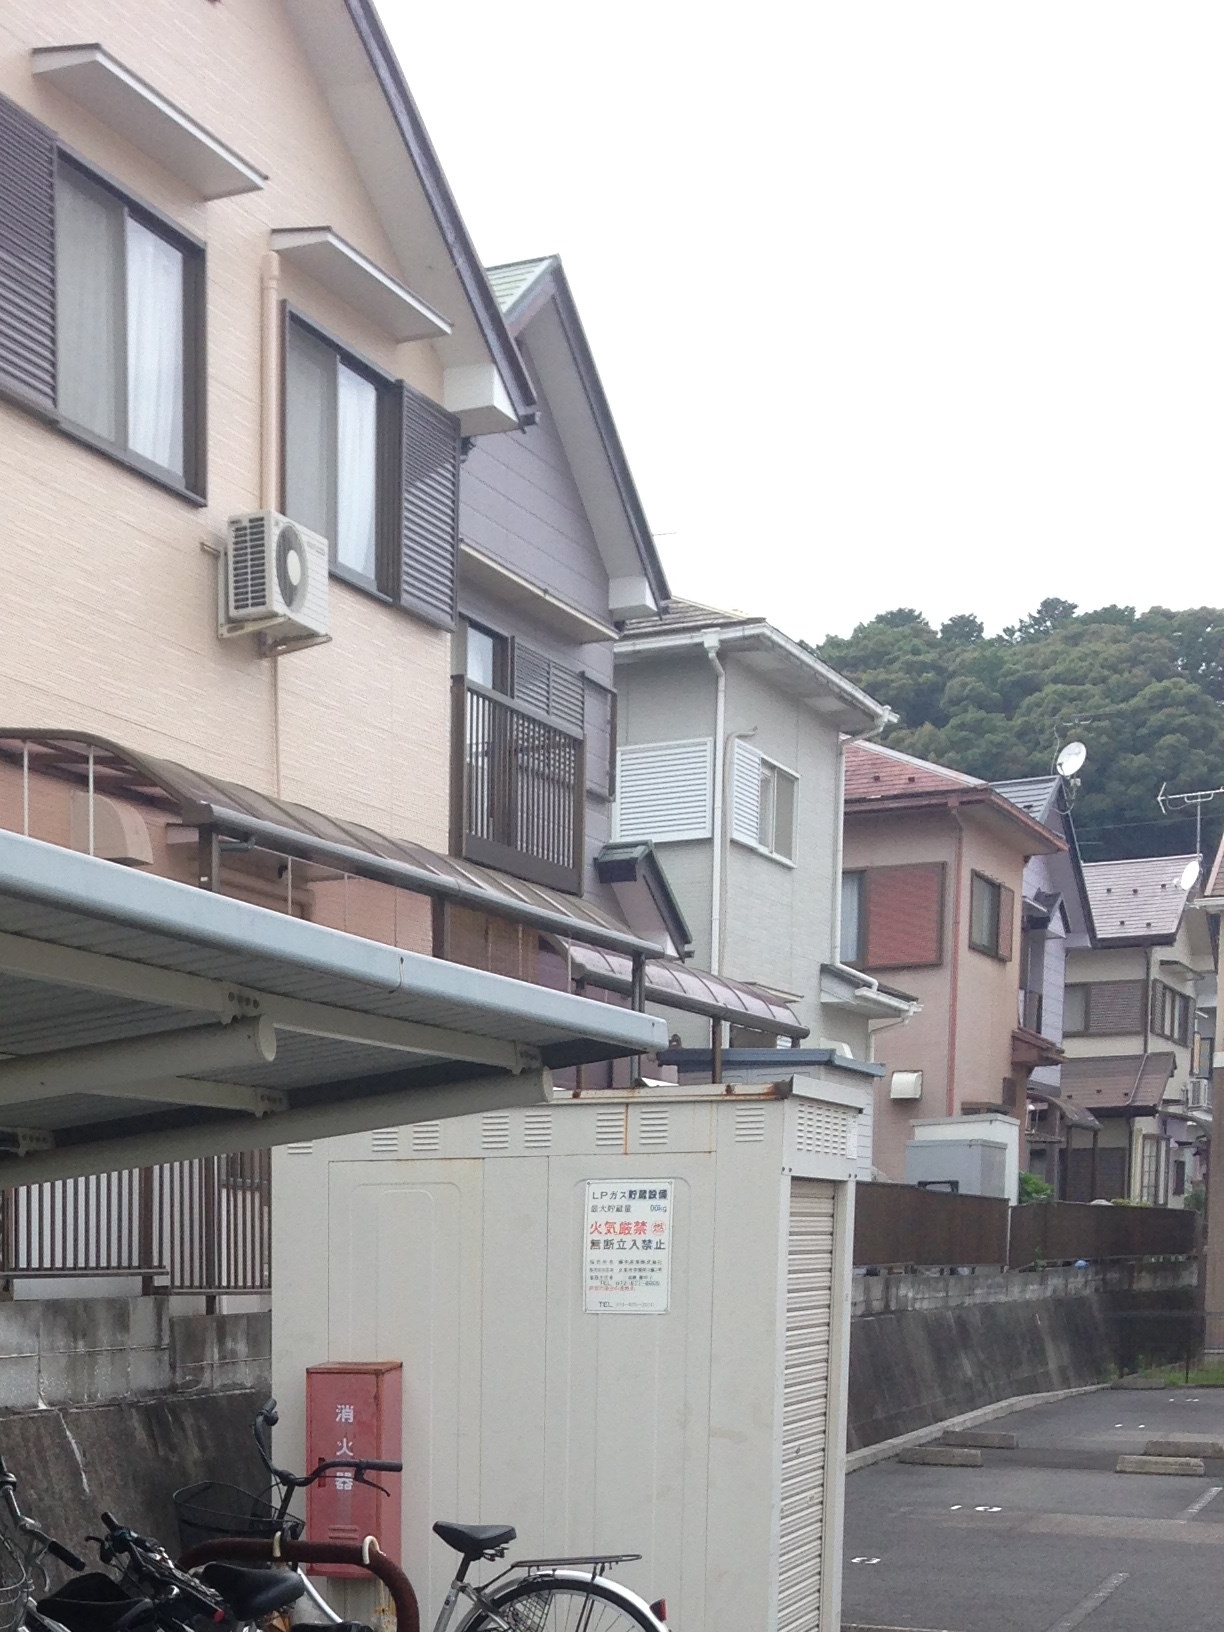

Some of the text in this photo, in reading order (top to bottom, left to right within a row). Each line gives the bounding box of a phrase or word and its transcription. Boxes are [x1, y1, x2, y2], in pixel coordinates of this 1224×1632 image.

[589, 1221, 648, 1235] 火気厳禁
[590, 1239, 666, 1251] 無断立入禁止
[335, 1404, 354, 1490] 消火器
